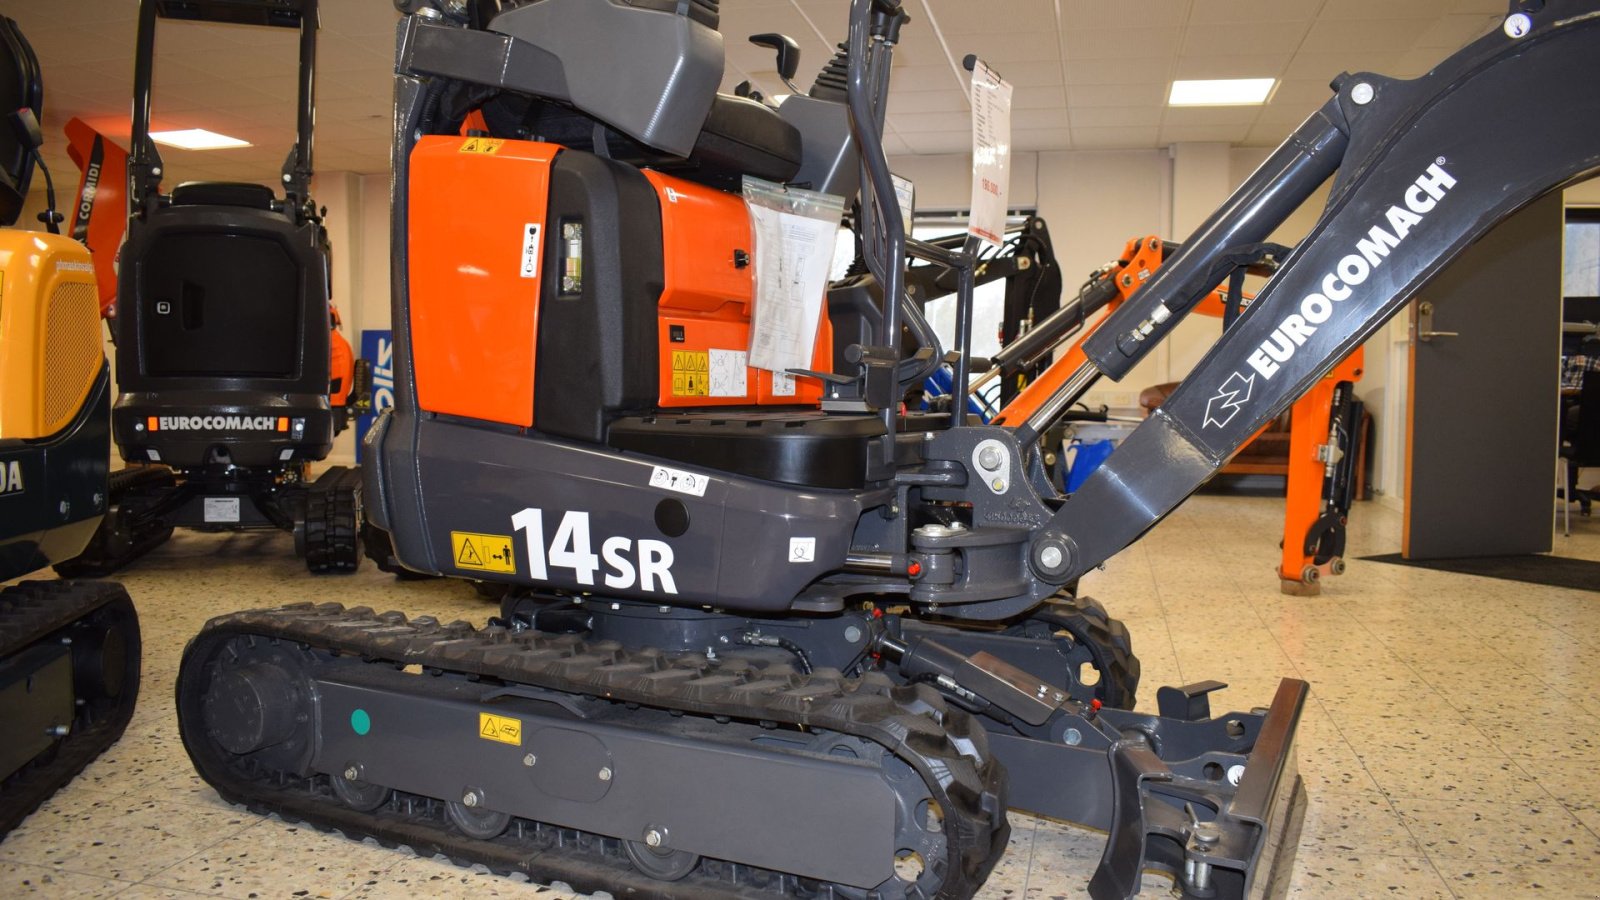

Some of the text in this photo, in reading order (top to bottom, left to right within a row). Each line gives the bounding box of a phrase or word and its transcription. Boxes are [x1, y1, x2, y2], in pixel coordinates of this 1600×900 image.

[79, 163, 100, 220] CORMIDI
[160, 416, 275, 431] EUROCOMACH
[511, 507, 679, 595] 14SR
